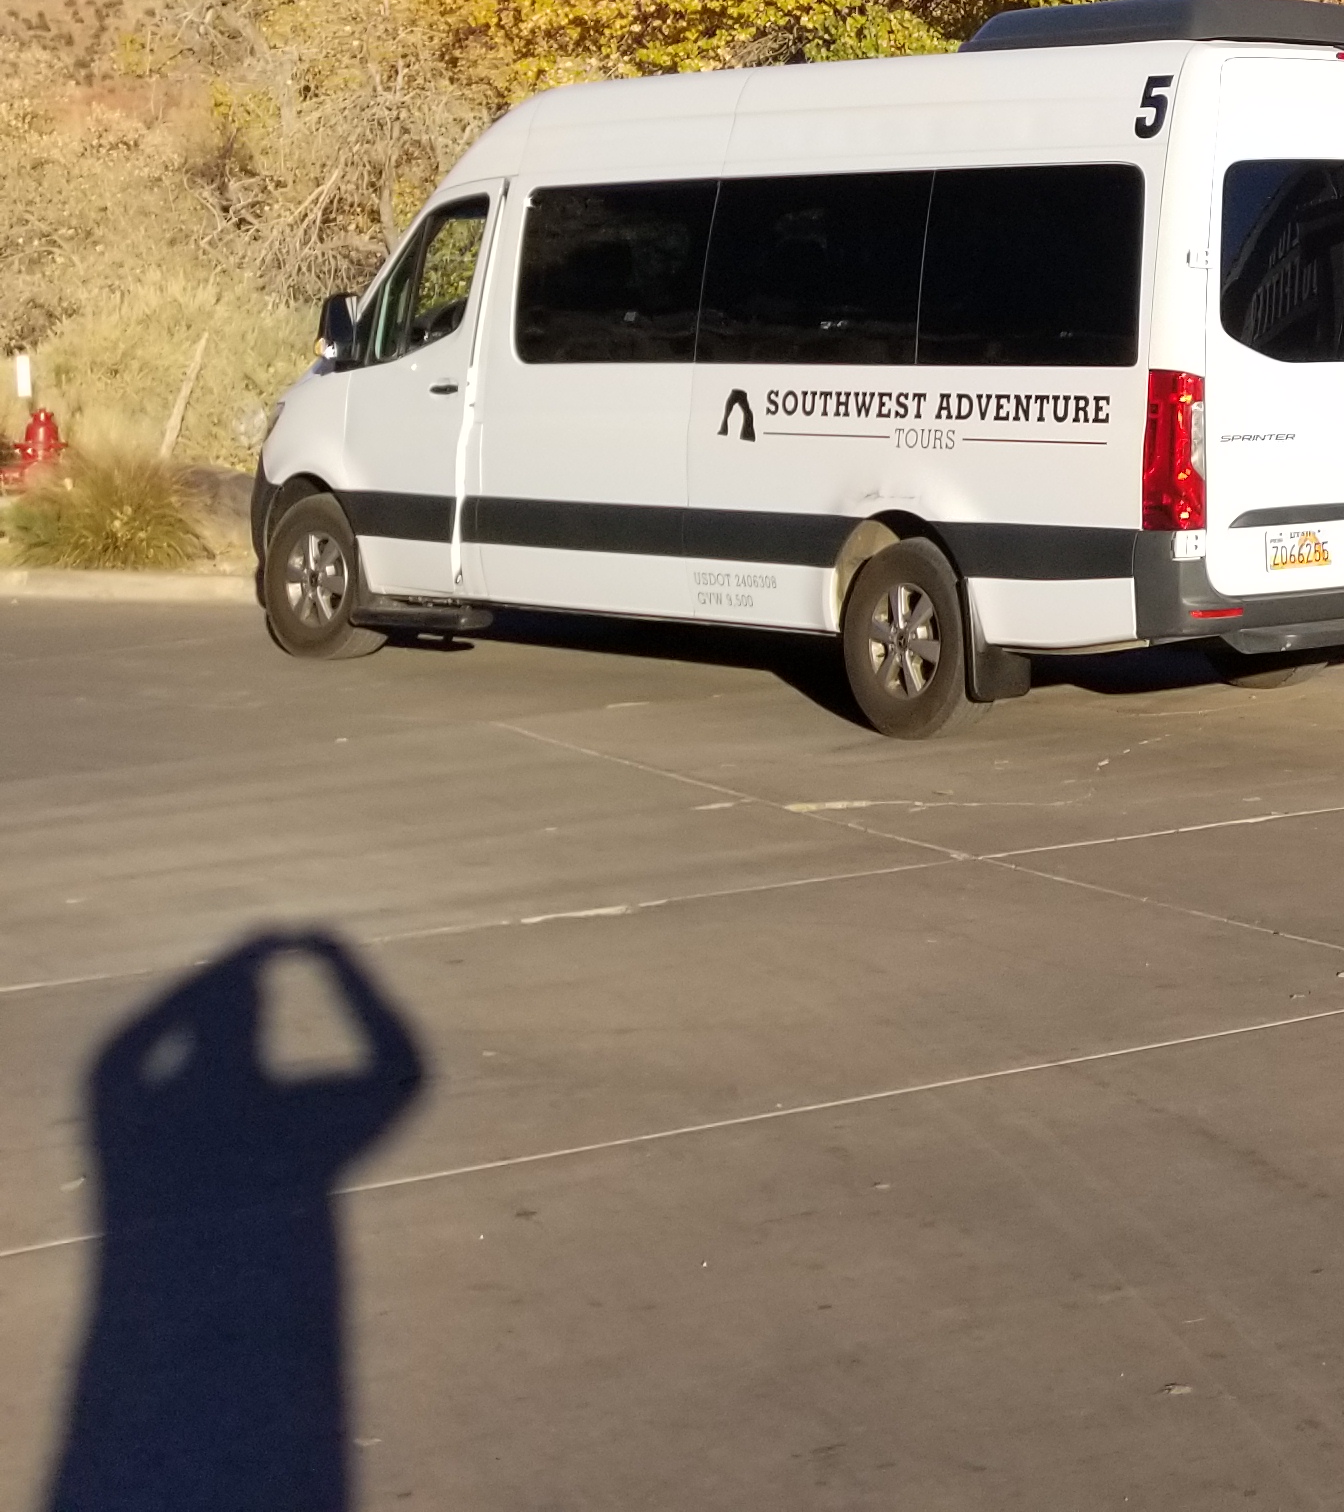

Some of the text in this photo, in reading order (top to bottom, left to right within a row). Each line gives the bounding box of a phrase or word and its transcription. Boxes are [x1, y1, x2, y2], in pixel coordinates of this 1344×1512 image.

[1135, 75, 1174, 139] 5
[765, 389, 1111, 425] SOUTHWEST ADVENTURE
[895, 428, 957, 451] TOURS
[1220, 433, 1296, 443] SPRINTER
[1272, 541, 1329, 566] Z066255
[694, 572, 777, 589] USDOT 2406308
[698, 592, 722, 605] GVW
